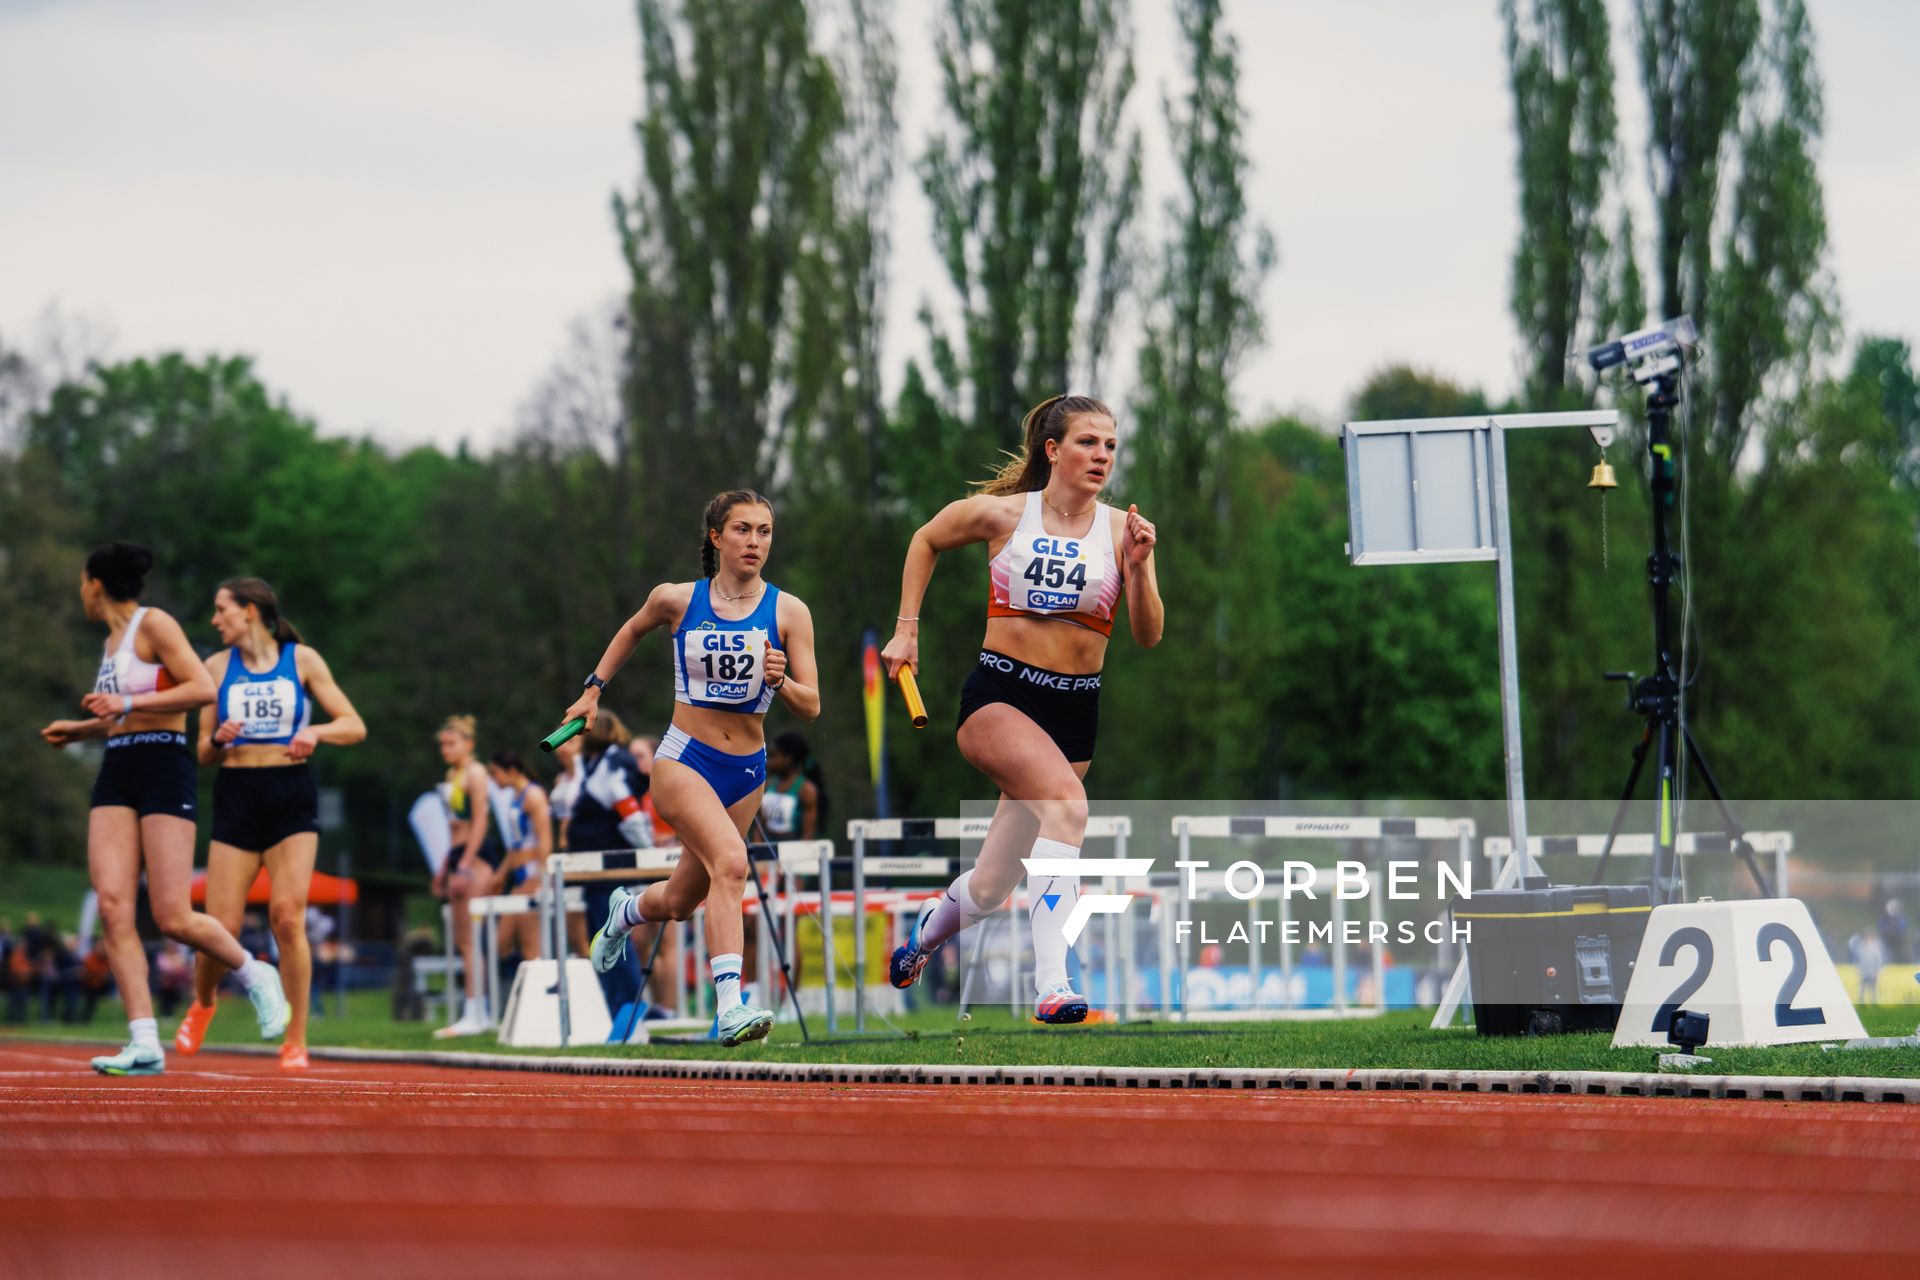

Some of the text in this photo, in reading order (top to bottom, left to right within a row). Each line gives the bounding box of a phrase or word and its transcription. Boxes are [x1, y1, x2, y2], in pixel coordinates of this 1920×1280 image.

[1024, 557, 1087, 591] 454
[1047, 595, 1077, 606] PLAN
[701, 654, 755, 681] 182
[1019, 667, 1073, 691] NIKE
[721, 685, 747, 694] PLAN
[242, 699, 284, 718] 185
[134, 732, 172, 744] PRO
[1651, 927, 1714, 1033] 2
[1756, 922, 1826, 1027] 2
